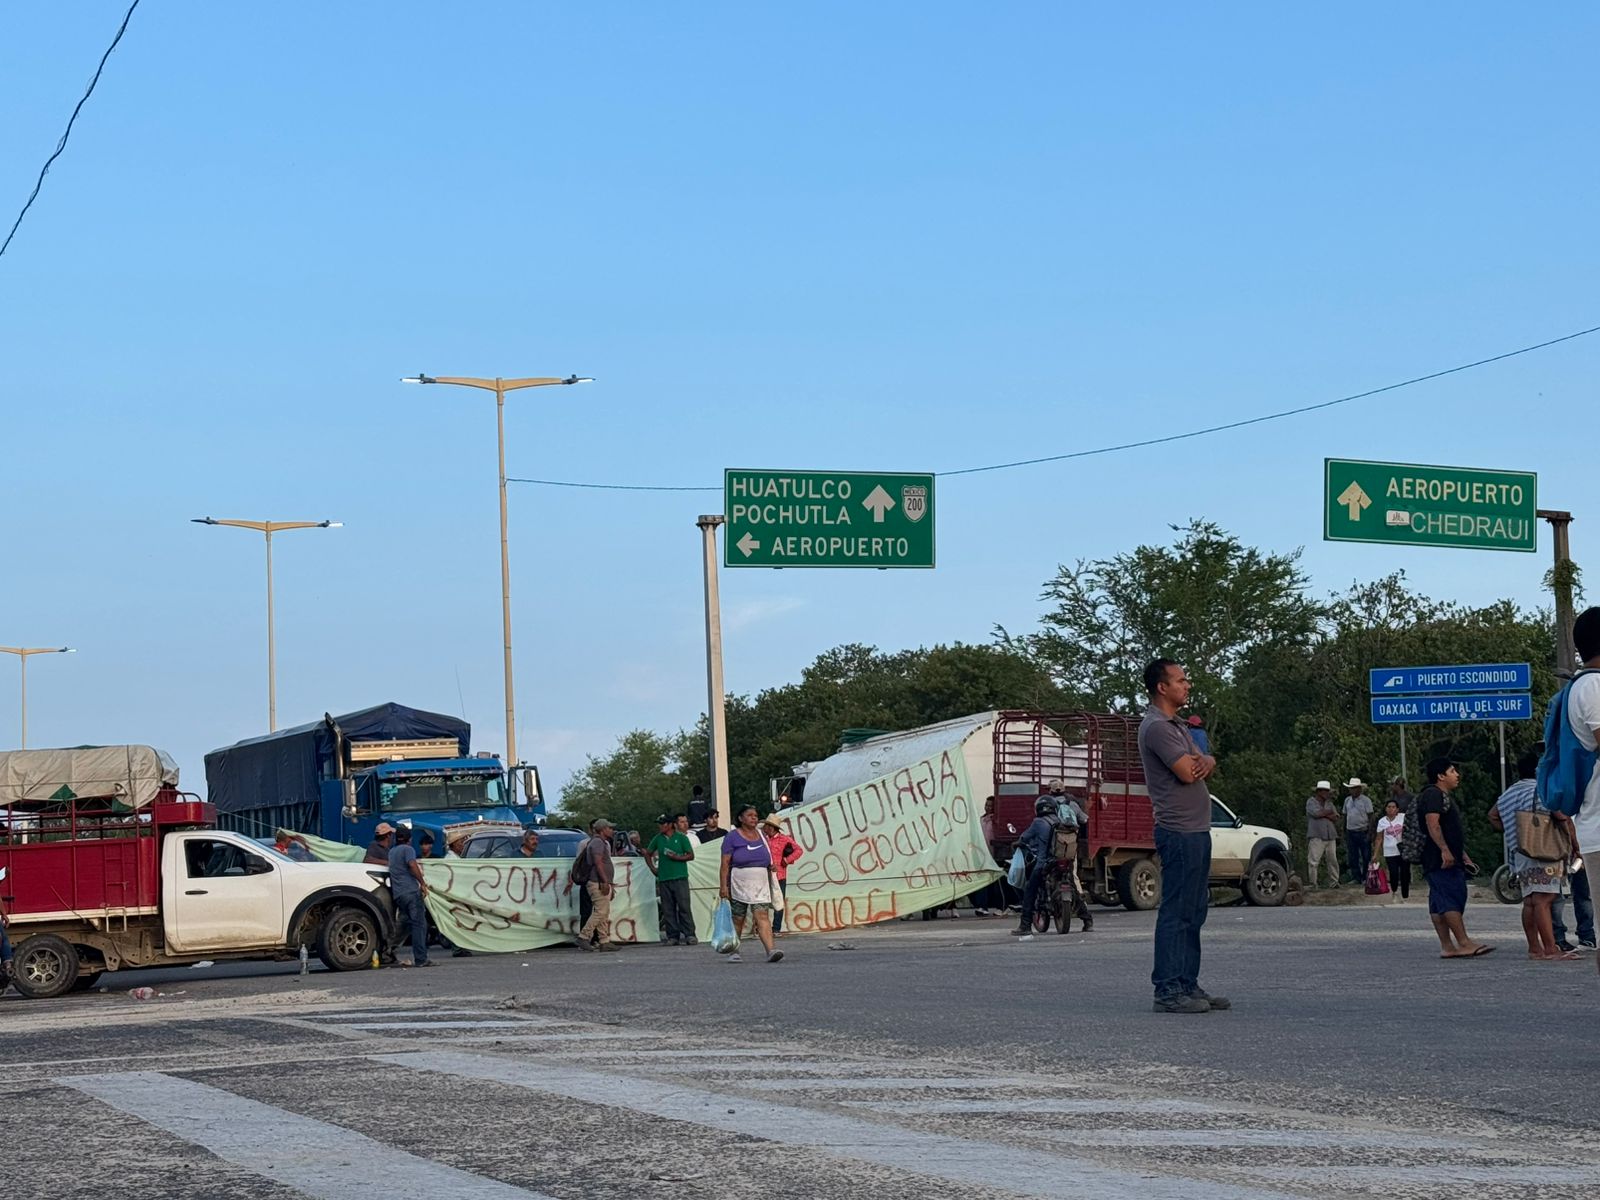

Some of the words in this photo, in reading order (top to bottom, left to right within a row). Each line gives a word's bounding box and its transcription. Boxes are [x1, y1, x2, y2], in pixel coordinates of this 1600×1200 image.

[732, 478, 852, 499] HUATULCO
[1386, 477, 1523, 506] AEROPUERTO
[907, 497, 923, 511] 200
[732, 505, 852, 525] POCHUTLA
[1410, 512, 1529, 541] CHEDRAUI
[771, 537, 909, 557] AEROPUERTO
[1418, 672, 1457, 686] PUERTO
[1459, 670, 1517, 684] ESCONDIDO
[1379, 703, 1418, 716] OAXACA
[1430, 701, 1471, 714] CAPITAL
[1475, 700, 1493, 712] DEL
[1497, 699, 1523, 712] SURF
